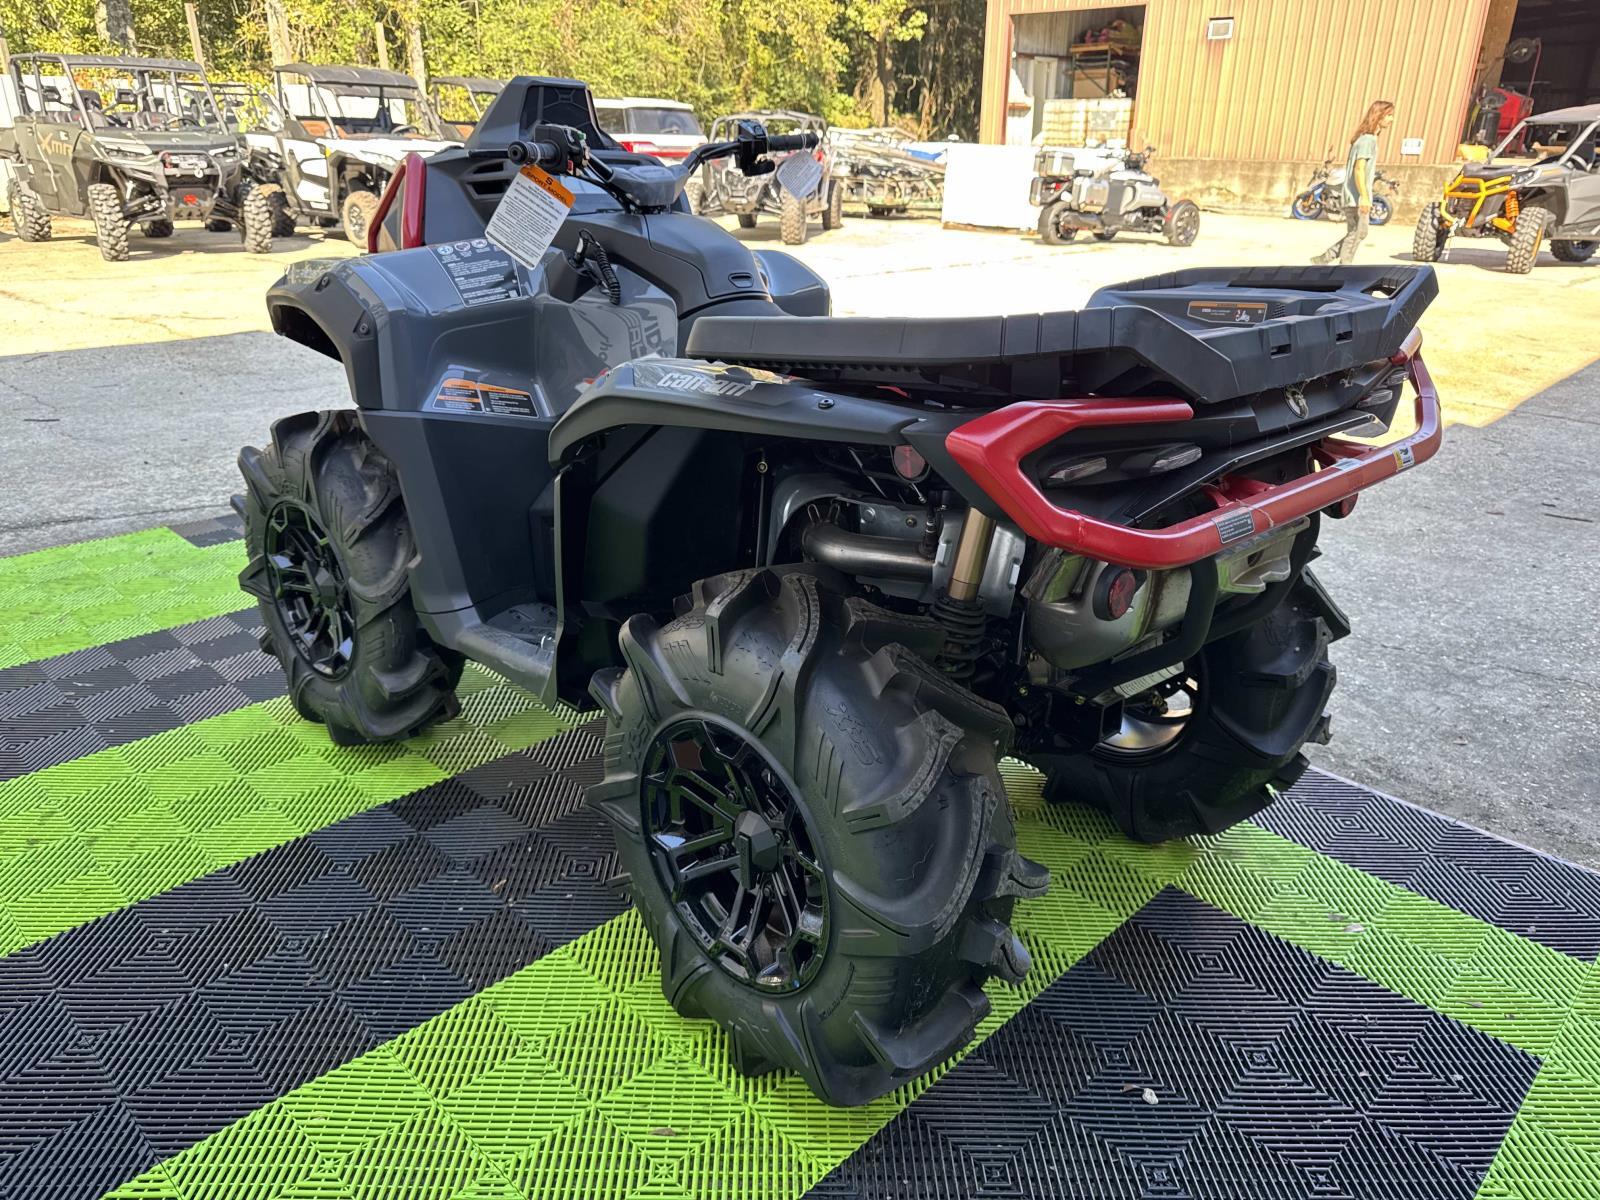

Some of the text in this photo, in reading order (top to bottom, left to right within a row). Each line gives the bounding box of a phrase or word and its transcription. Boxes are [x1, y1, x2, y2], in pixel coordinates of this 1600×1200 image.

[526, 171, 568, 205] SPORT MODEL
[546, 176, 554, 186] S
